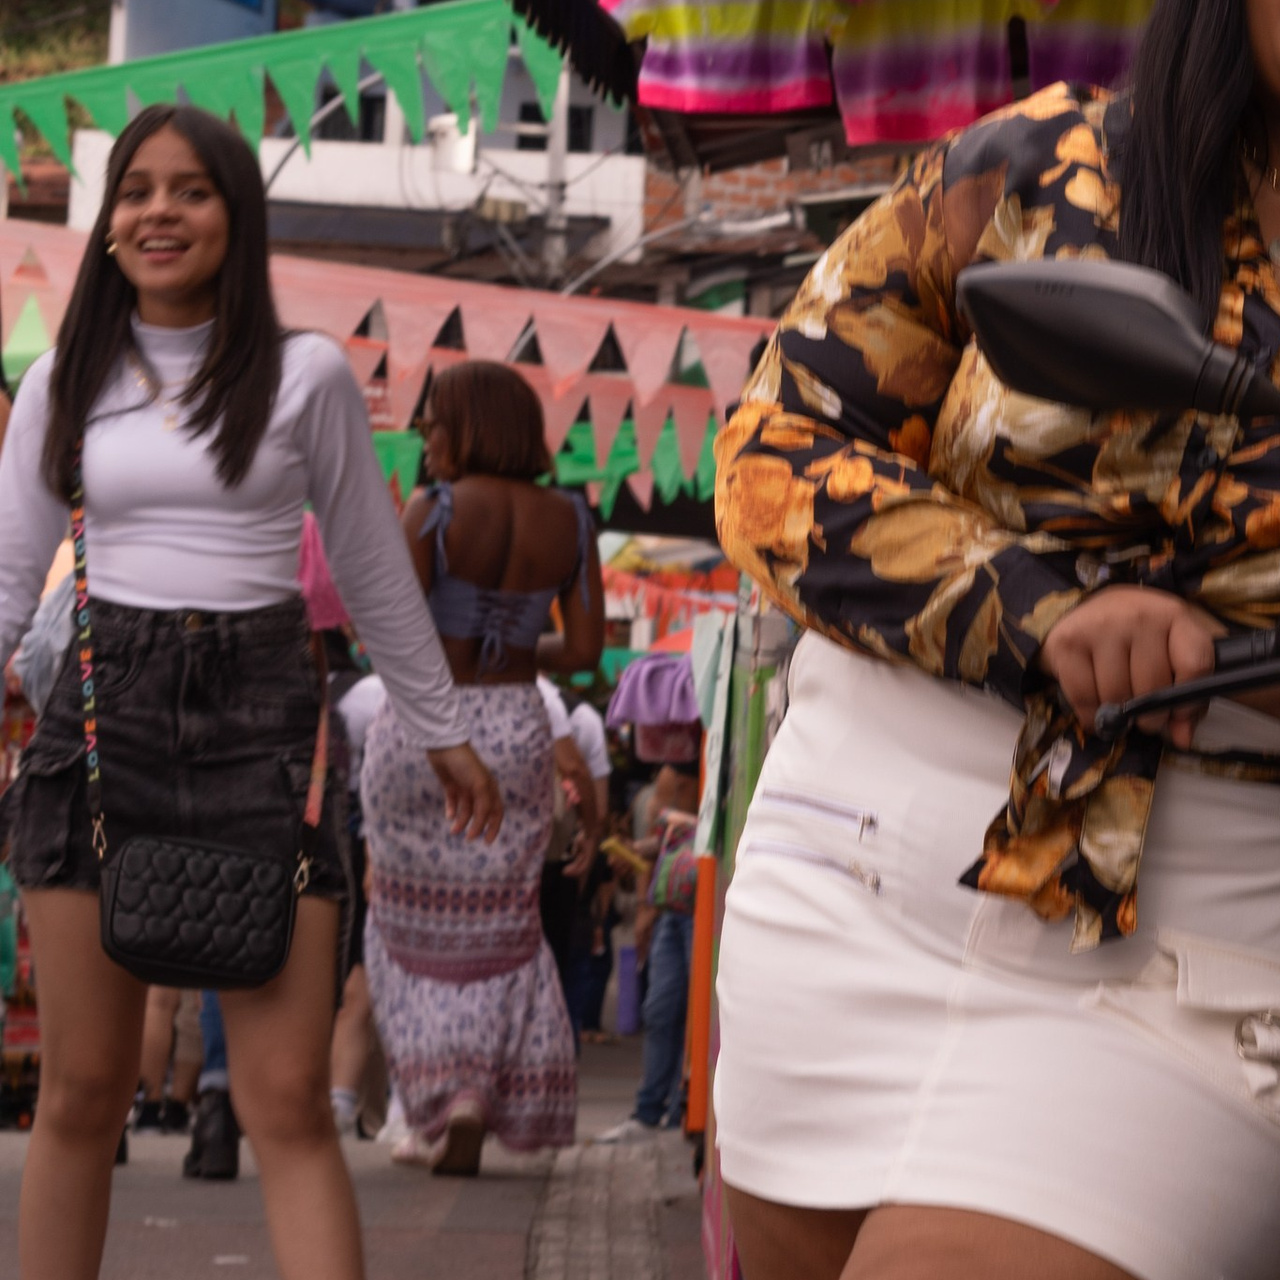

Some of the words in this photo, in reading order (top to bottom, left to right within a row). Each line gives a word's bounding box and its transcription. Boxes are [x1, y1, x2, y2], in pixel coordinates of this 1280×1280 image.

[71, 507, 87, 569] LOVE
[75, 577, 92, 640] LOVE
[79, 646, 95, 711] LOVE
[84, 718, 100, 783] LOVE
